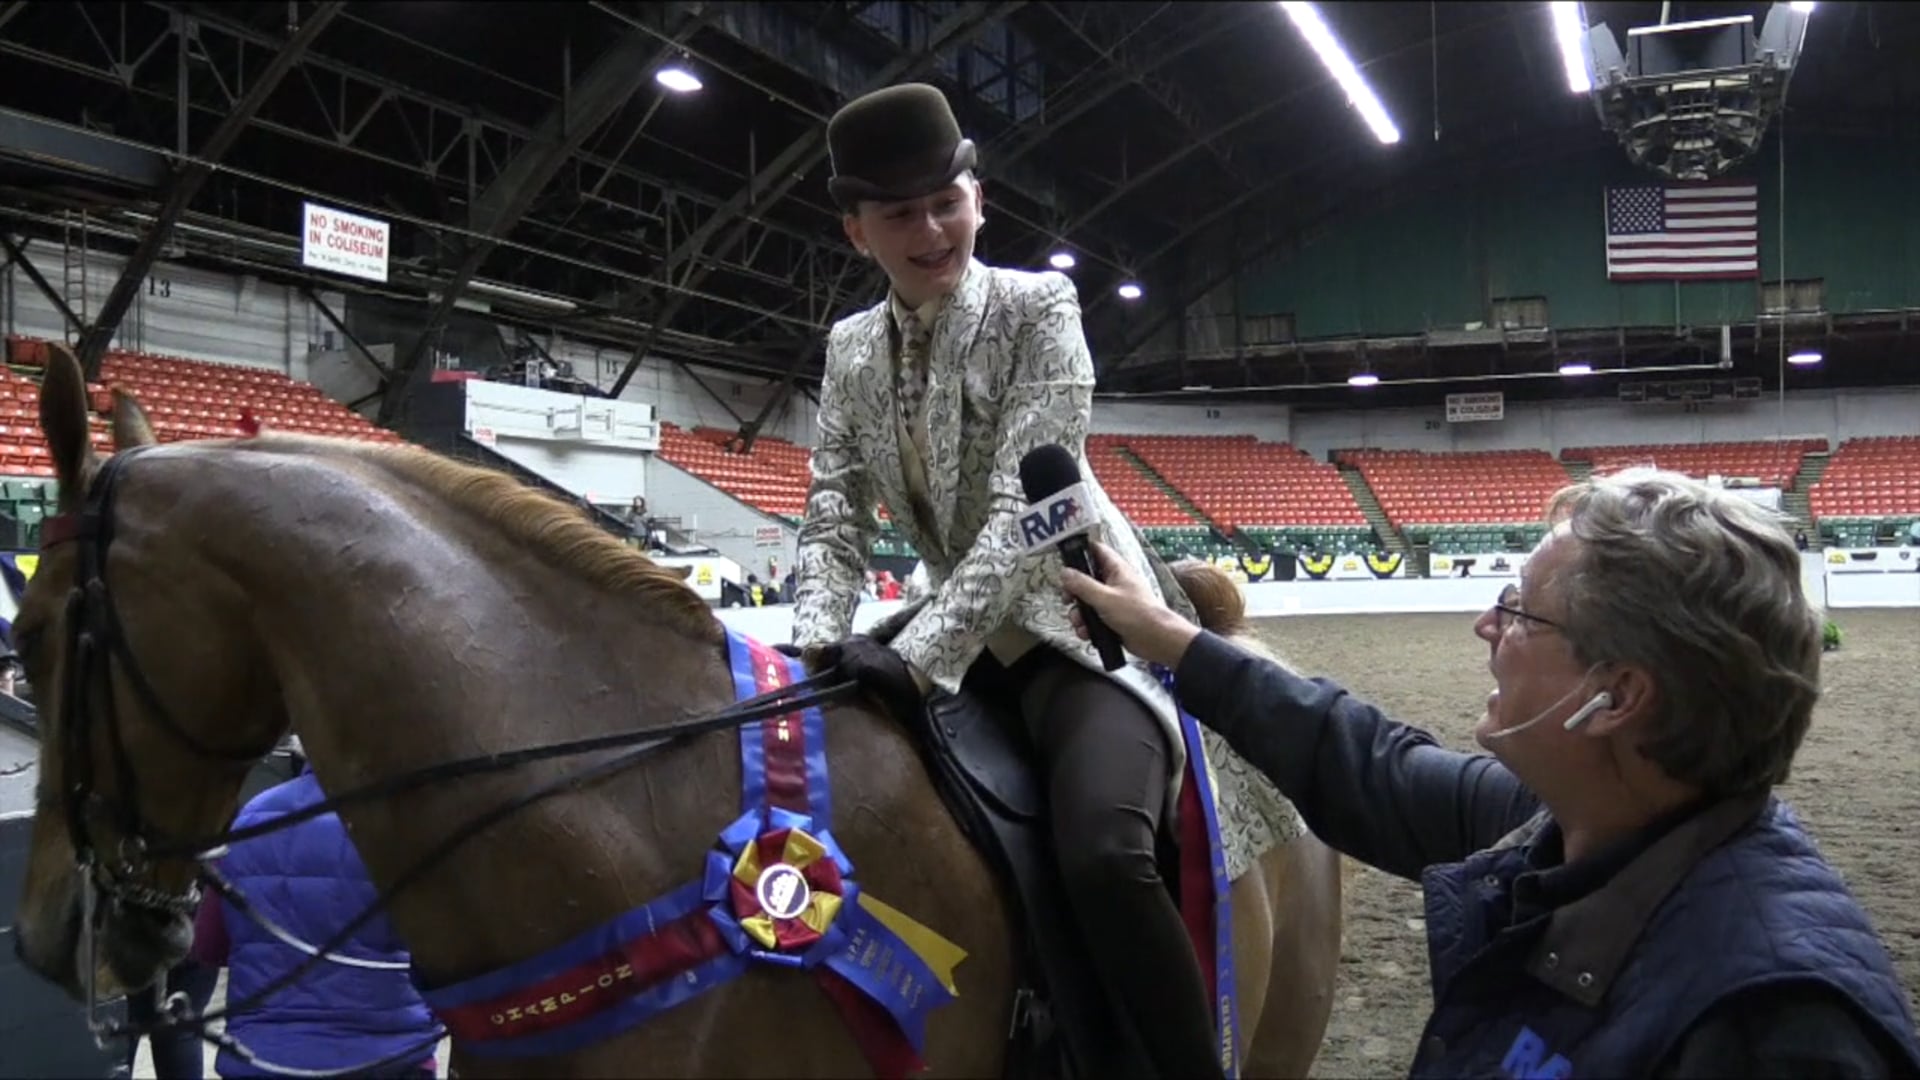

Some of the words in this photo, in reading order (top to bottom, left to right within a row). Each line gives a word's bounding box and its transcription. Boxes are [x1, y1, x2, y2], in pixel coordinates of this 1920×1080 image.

[310, 213, 328, 229] NO
[333, 218, 384, 243] SMOKING
[309, 230, 321, 245] IN
[327, 234, 384, 259] COLISEUM
[149, 276, 170, 298] 13
[1020, 498, 1069, 547] RVP
[490, 963, 633, 1026] CHAMPION
